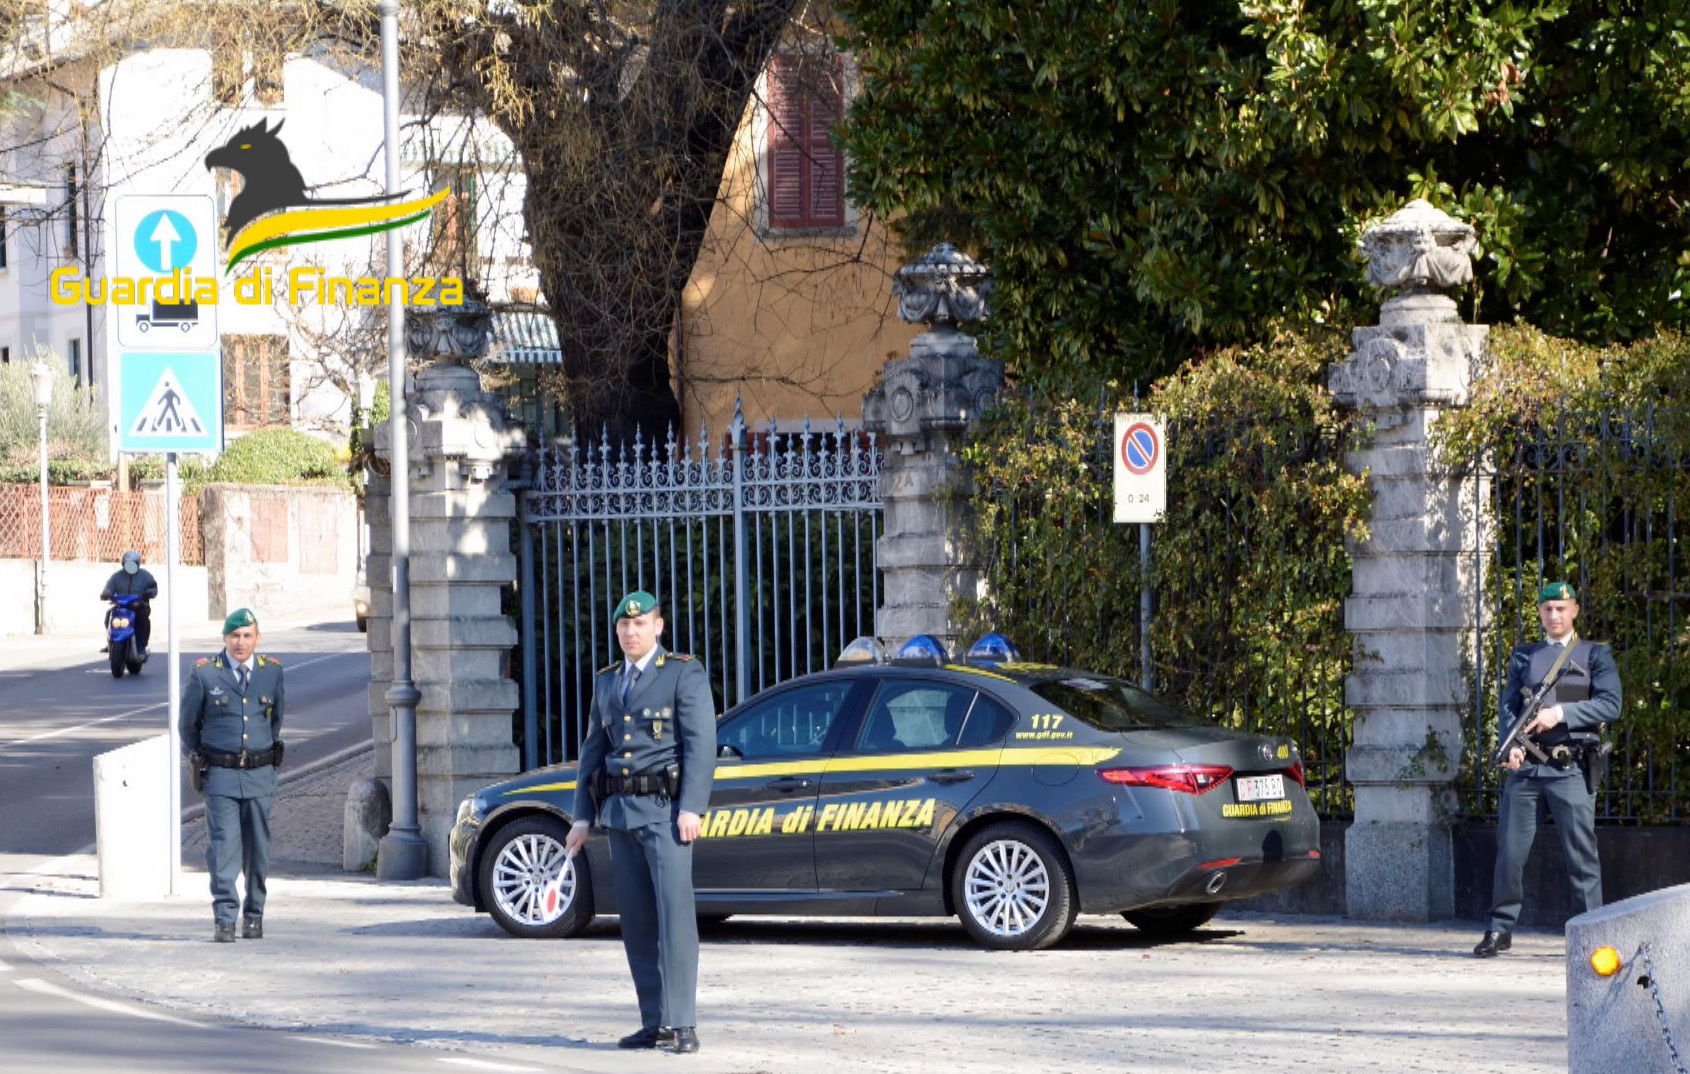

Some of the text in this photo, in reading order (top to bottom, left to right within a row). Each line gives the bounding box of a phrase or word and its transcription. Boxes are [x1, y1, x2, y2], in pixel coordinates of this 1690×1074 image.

[1138, 494, 1150, 503] 24
[1031, 713, 1064, 729] 117
[1015, 730, 1073, 740] www.gdf.gov.it
[1222, 800, 1292, 818] GUARDIA di FINANZA
[700, 799, 935, 837] ARDIA di FINANZA
